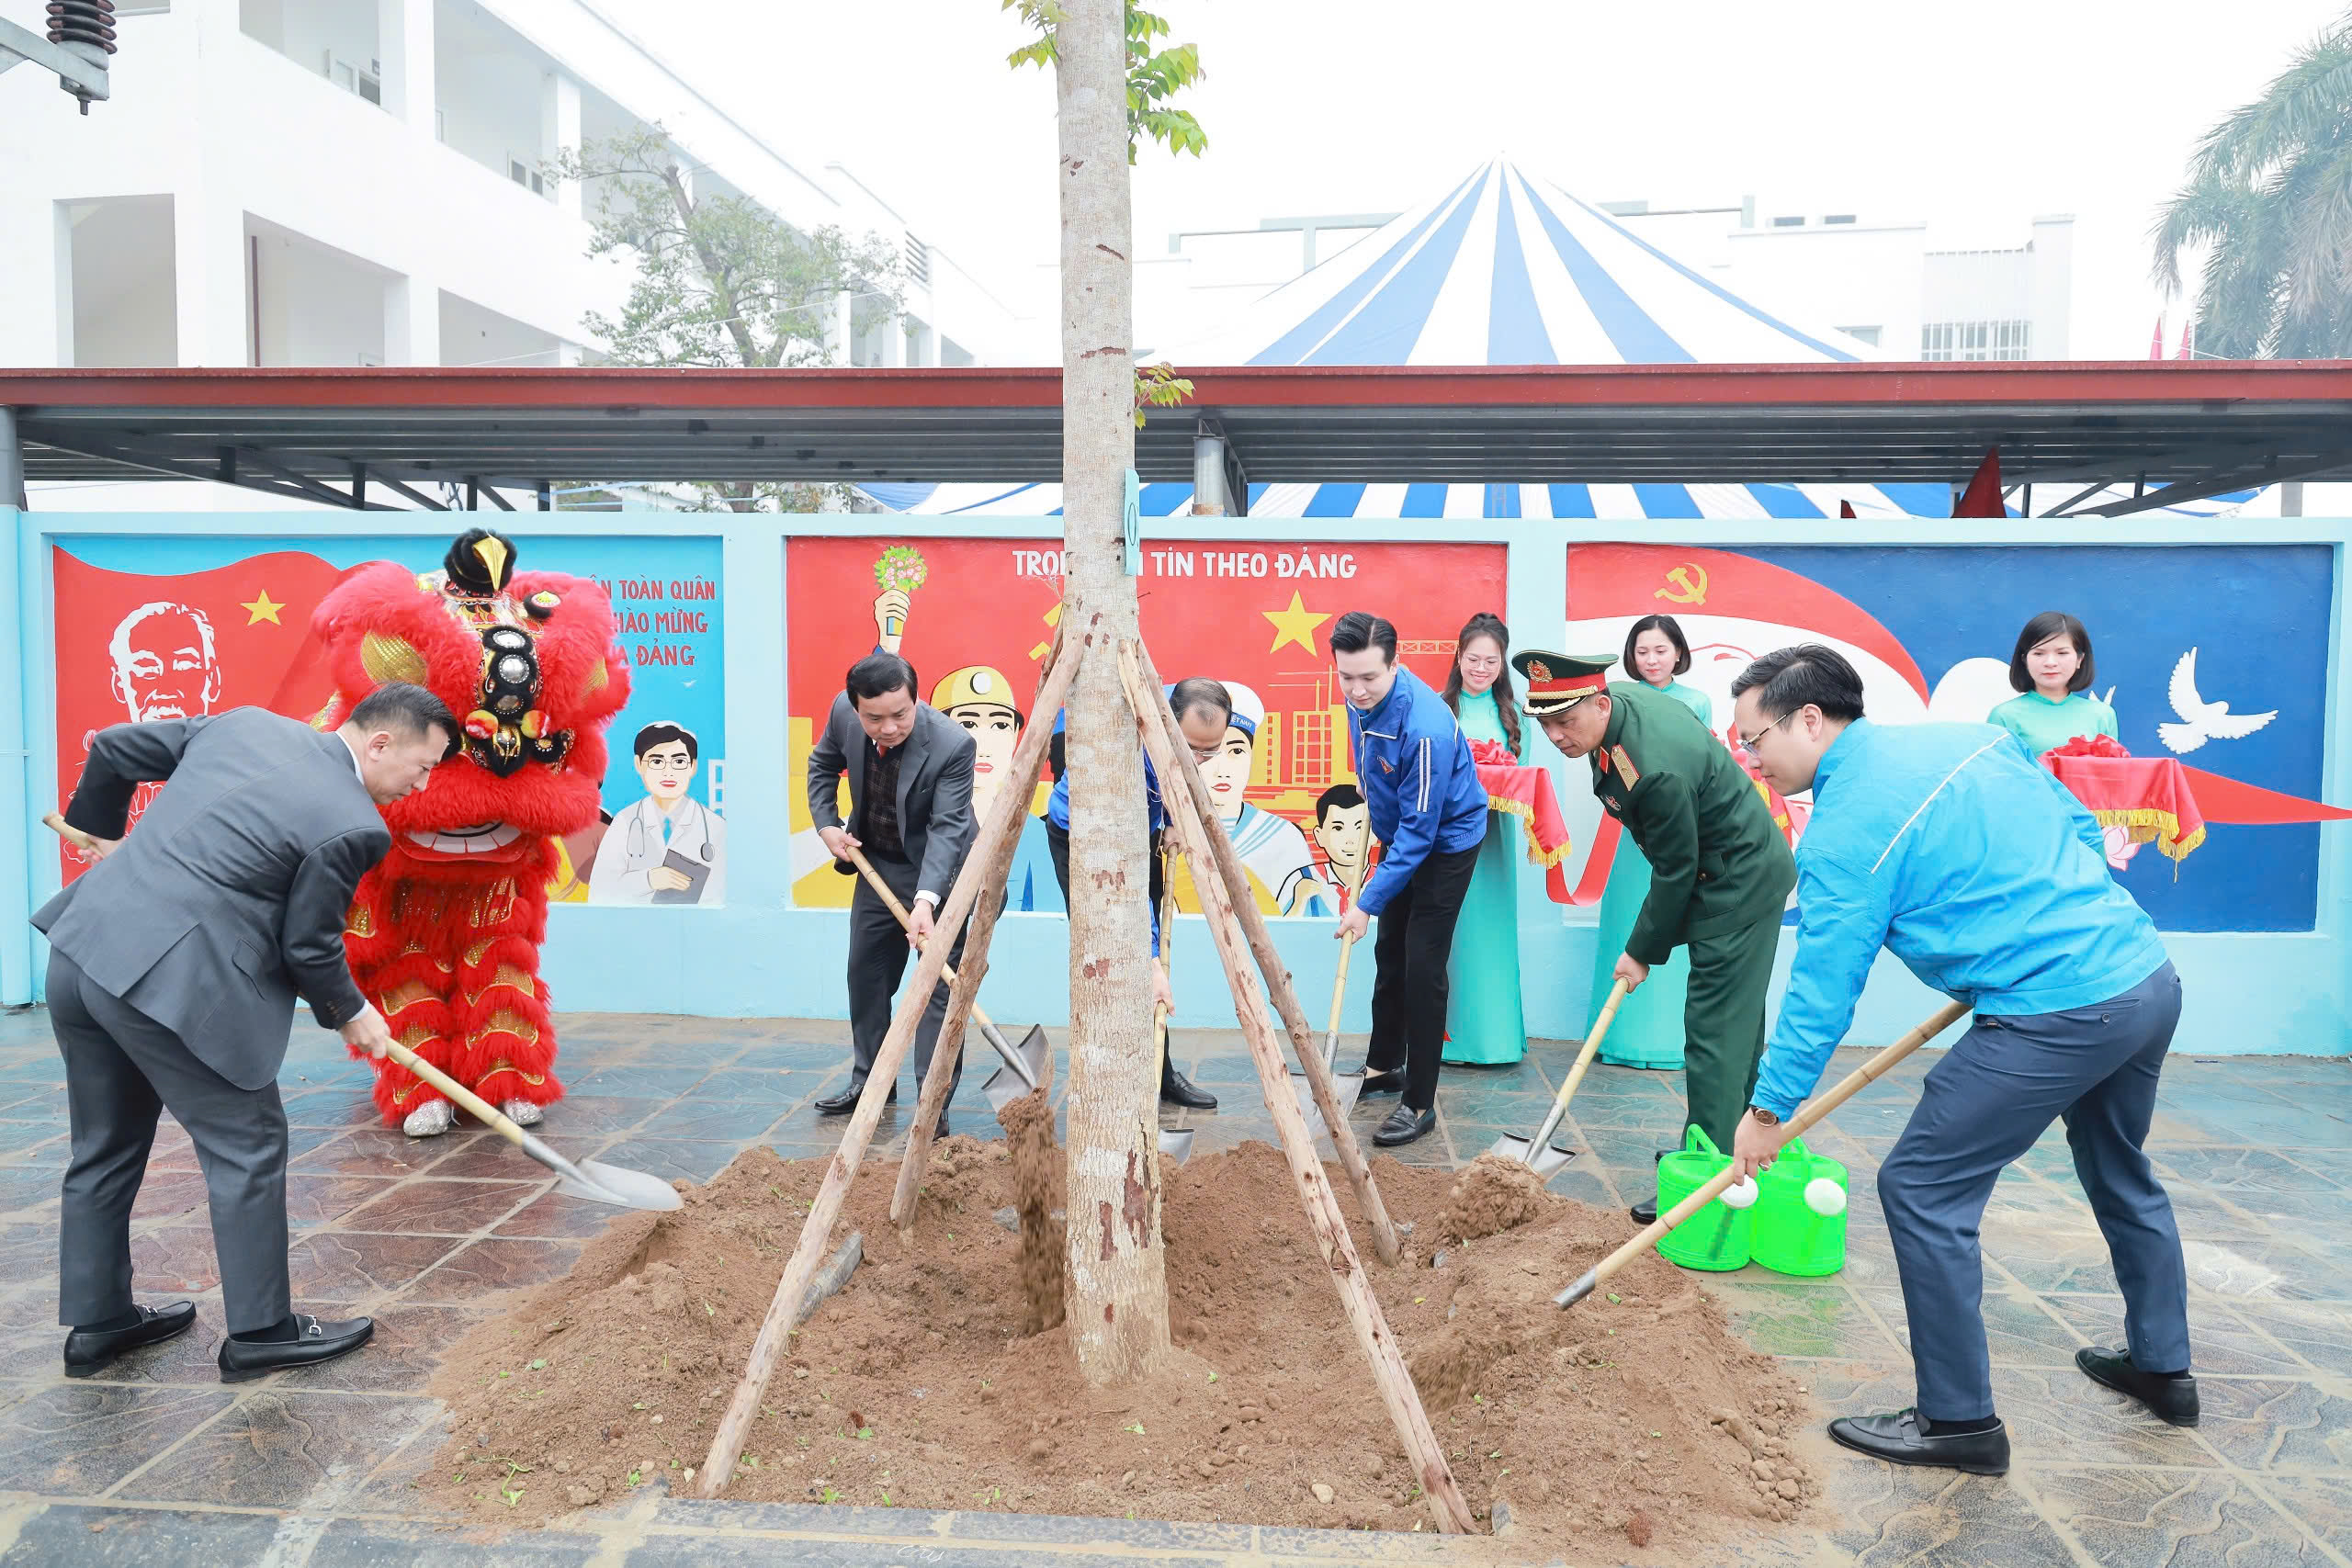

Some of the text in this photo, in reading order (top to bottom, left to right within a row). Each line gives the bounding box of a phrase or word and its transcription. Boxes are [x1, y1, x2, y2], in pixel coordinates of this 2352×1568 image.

[1202, 551, 1269, 578] THEO
[1274, 546, 1358, 579] ĐẢNG
[618, 574, 663, 600] TOÀN
[670, 574, 716, 600] QUÂN
[654, 606, 708, 634] MỪNG
[636, 638, 695, 667] ĐẢNG
